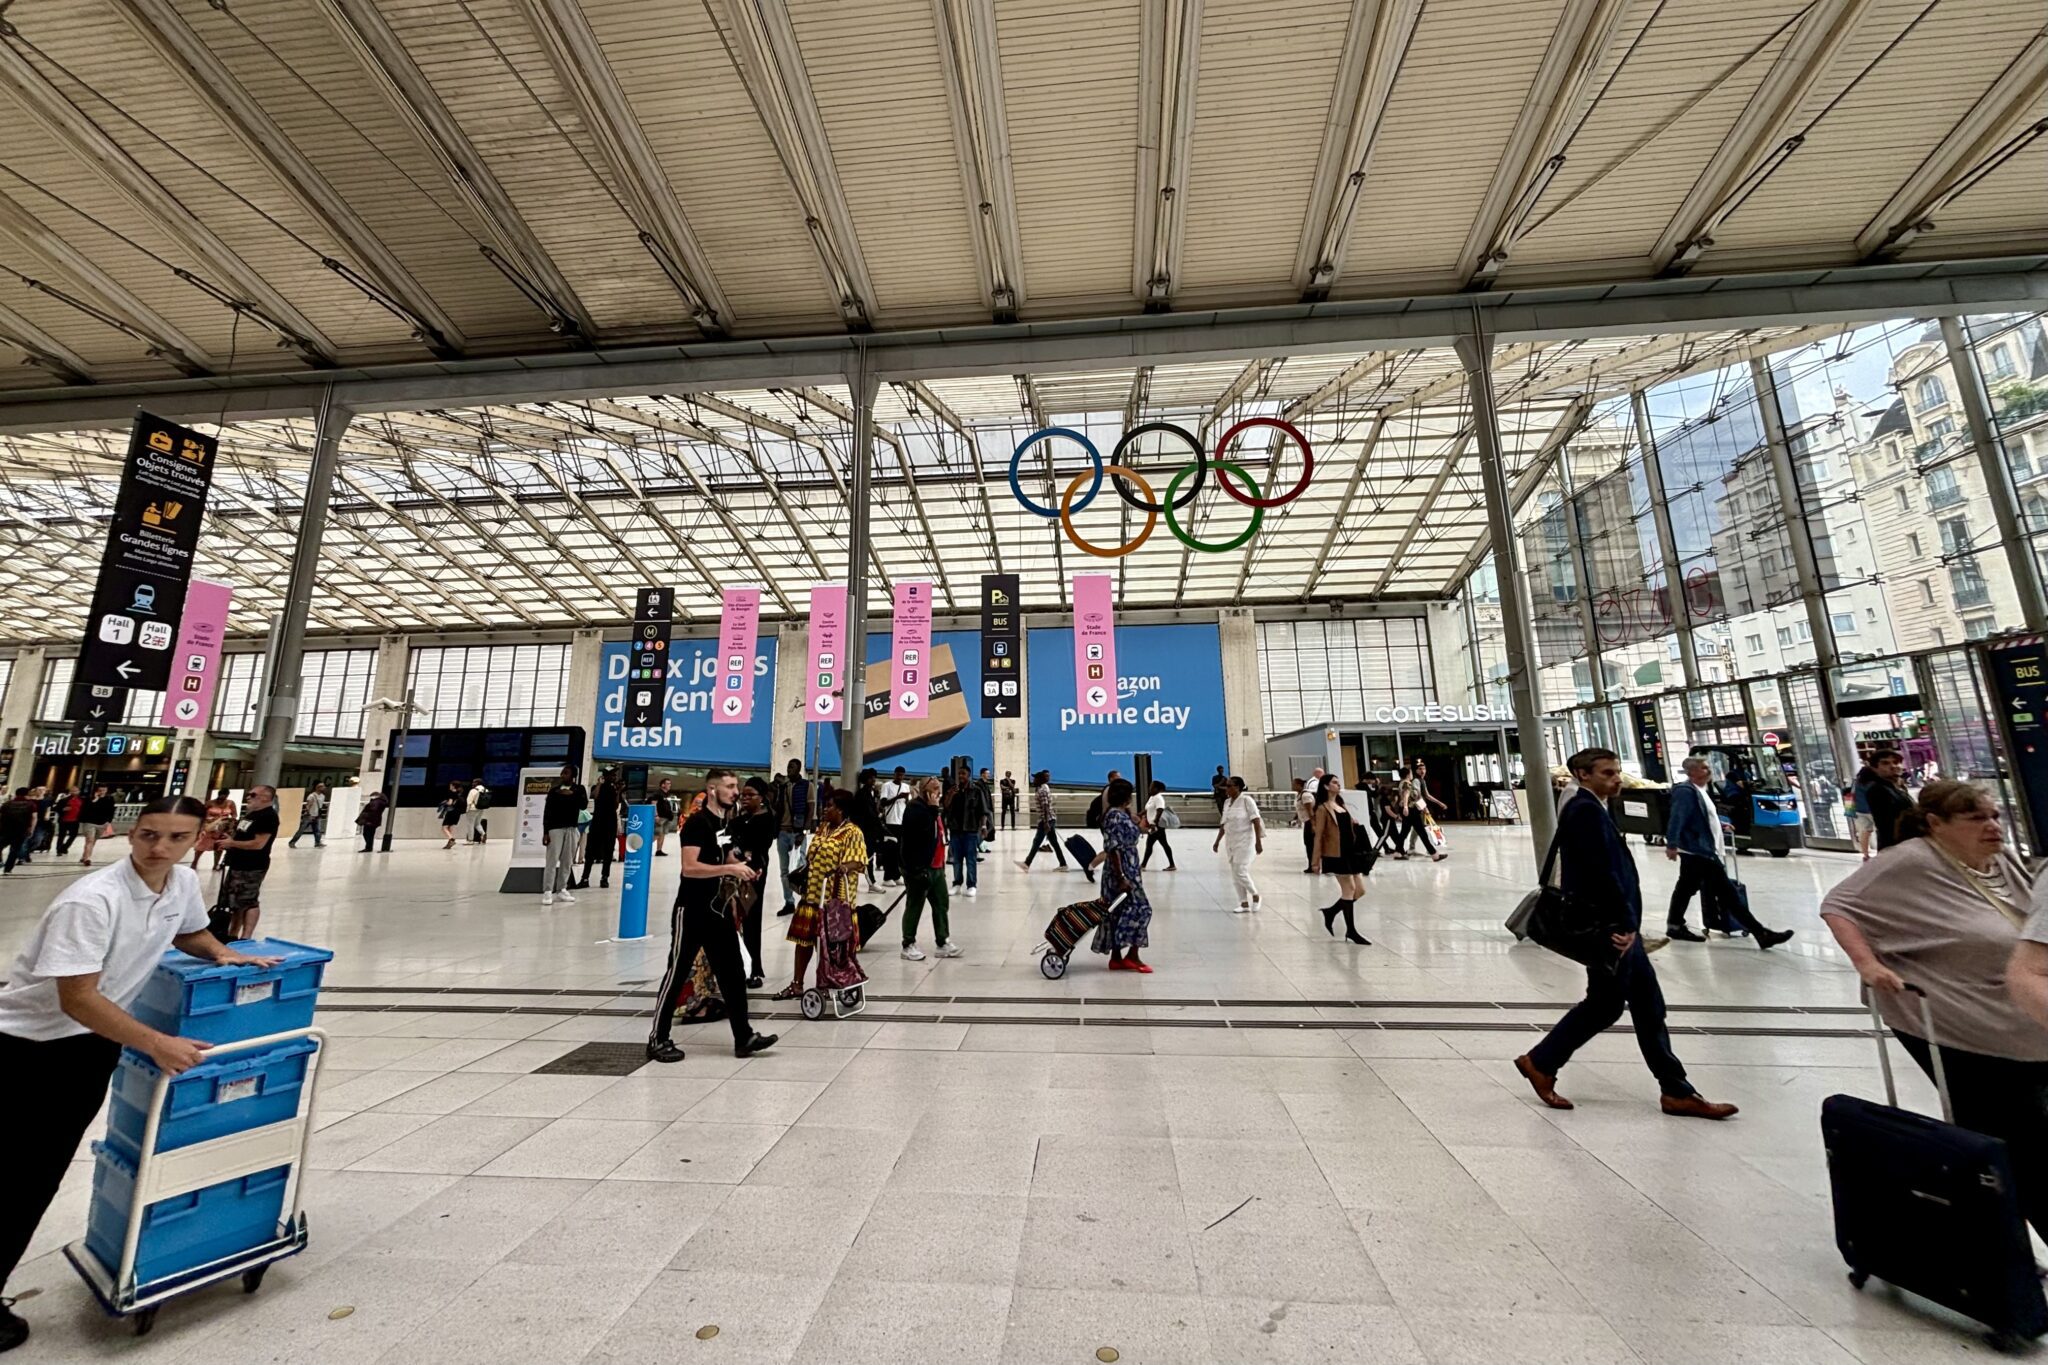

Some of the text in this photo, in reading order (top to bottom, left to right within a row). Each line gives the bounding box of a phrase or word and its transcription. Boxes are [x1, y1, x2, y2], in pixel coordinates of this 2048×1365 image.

[150, 452, 198, 475] Consignes
[136, 457, 206, 487] Objets trouvés
[139, 529, 175, 544] Billetterie
[120, 533, 189, 558] Grandes lignes
[107, 617, 129, 628] Hall
[146, 623, 167, 634] Hall
[993, 617, 1008, 626] BUS
[113, 629, 121, 641] 1
[142, 633, 152, 646] 2
[608, 654, 684, 680] Dx
[2015, 665, 2040, 679] BUS
[187, 679, 198, 690] H
[1117, 676, 1161, 690] azon
[95, 686, 109, 696] 3B
[986, 687, 997, 695] 3A
[1004, 687, 1015, 695] 3B
[865, 696, 891, 713] 16-
[1143, 700, 1191, 730] day
[602, 717, 682, 748] Flash
[1863, 731, 1899, 740] HOTEL
[31, 736, 71, 755] Hall
[73, 736, 100, 755] 3B
